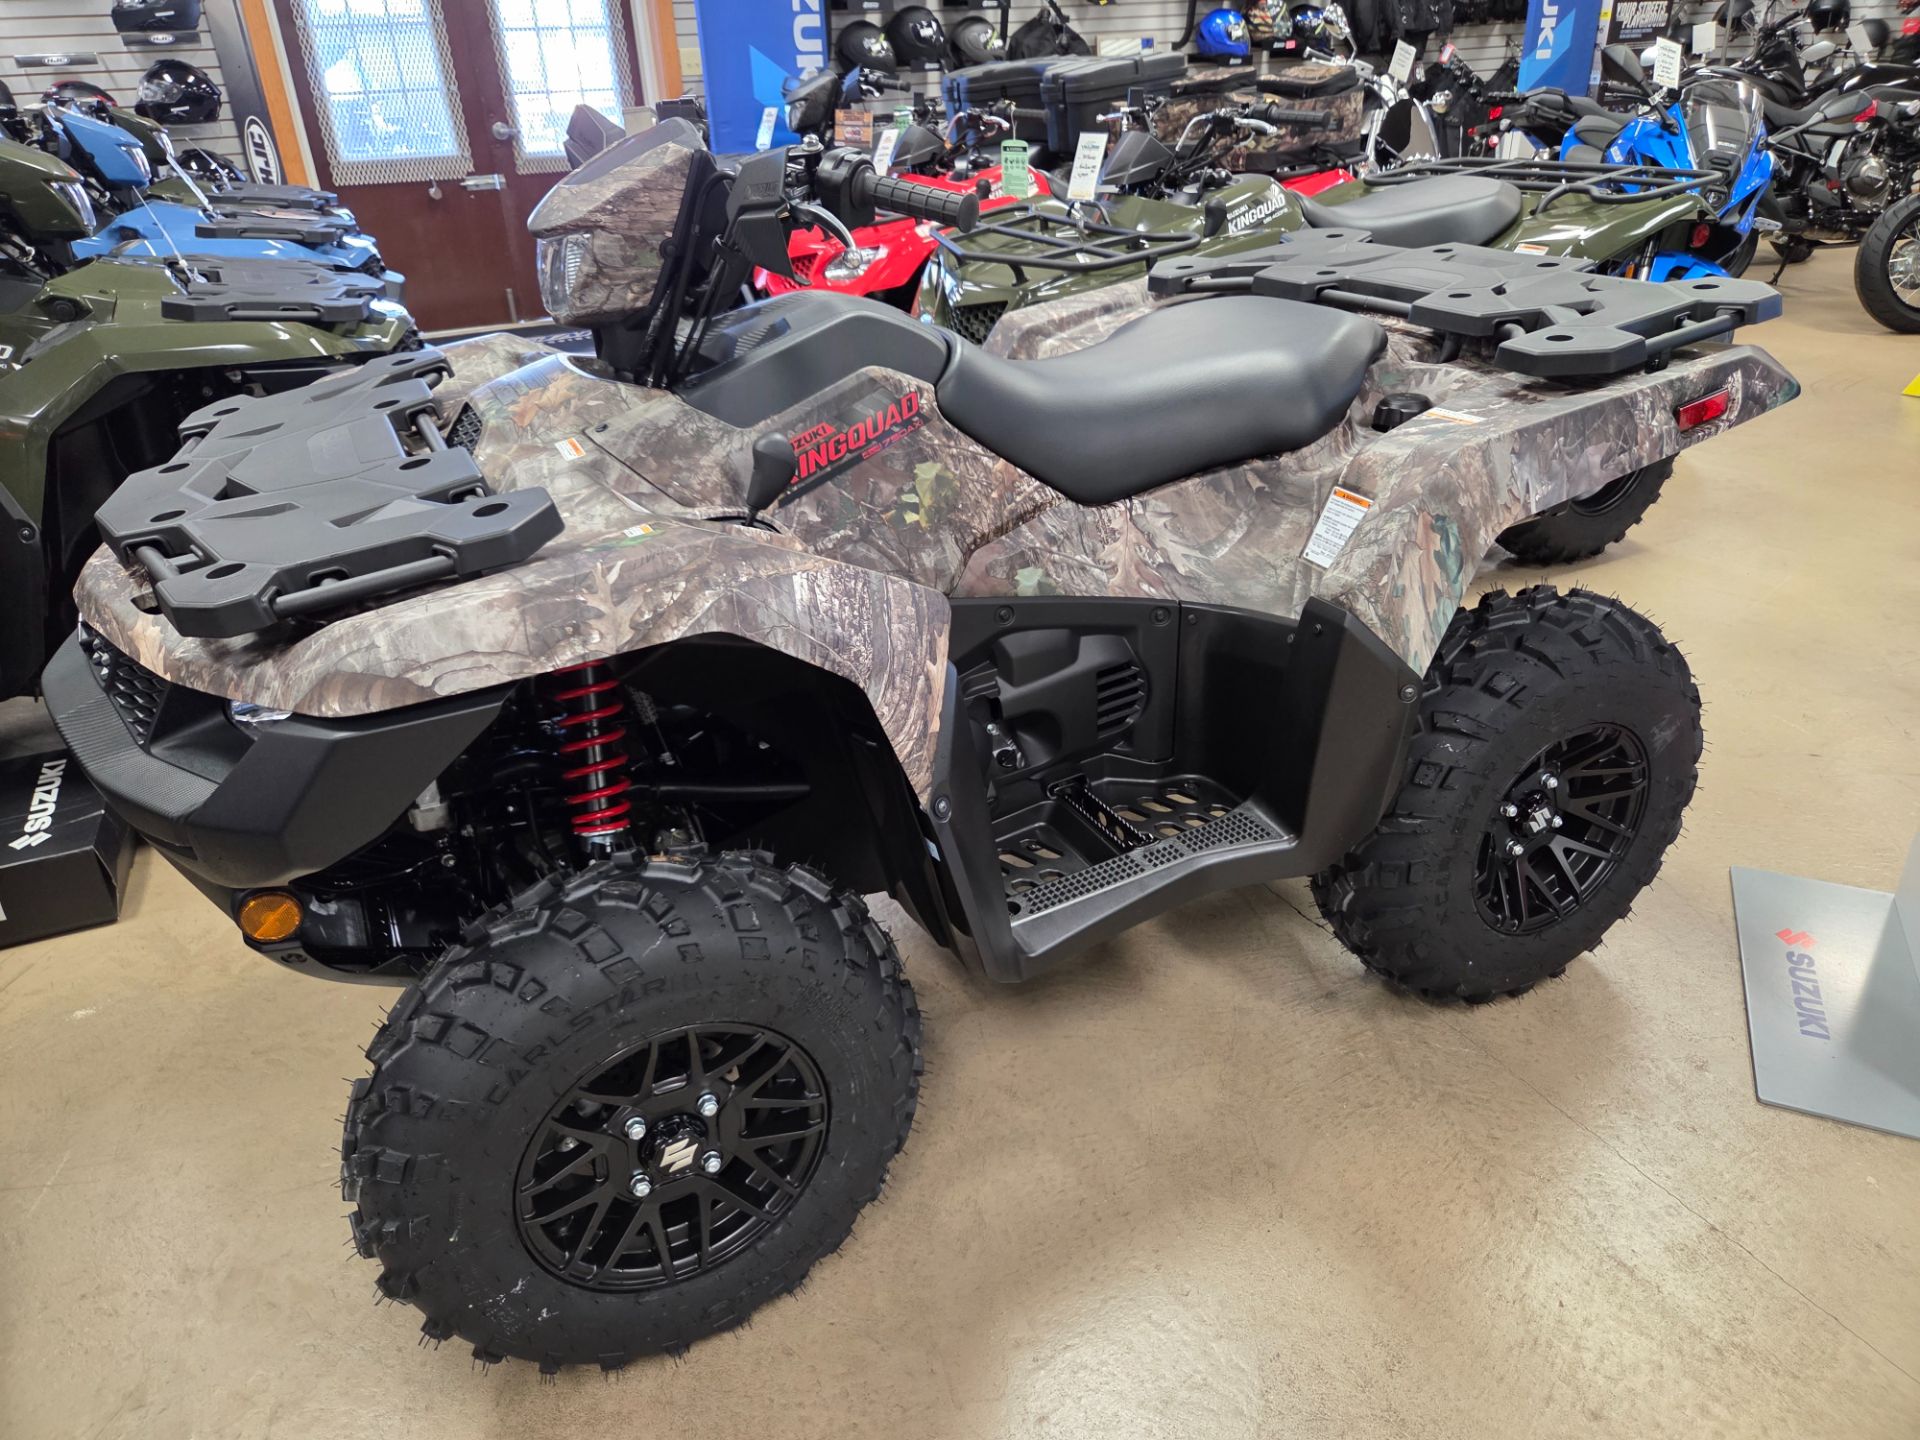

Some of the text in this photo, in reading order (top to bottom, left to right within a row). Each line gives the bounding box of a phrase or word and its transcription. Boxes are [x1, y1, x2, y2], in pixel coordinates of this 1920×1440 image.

[1228, 193, 1286, 235] KINGQUAD
[790, 424, 829, 449] ZUKI
[790, 391, 919, 484] INGQUAD
[24, 758, 67, 833] SUZUKI
[1785, 950, 1831, 1041] SUZUKI
